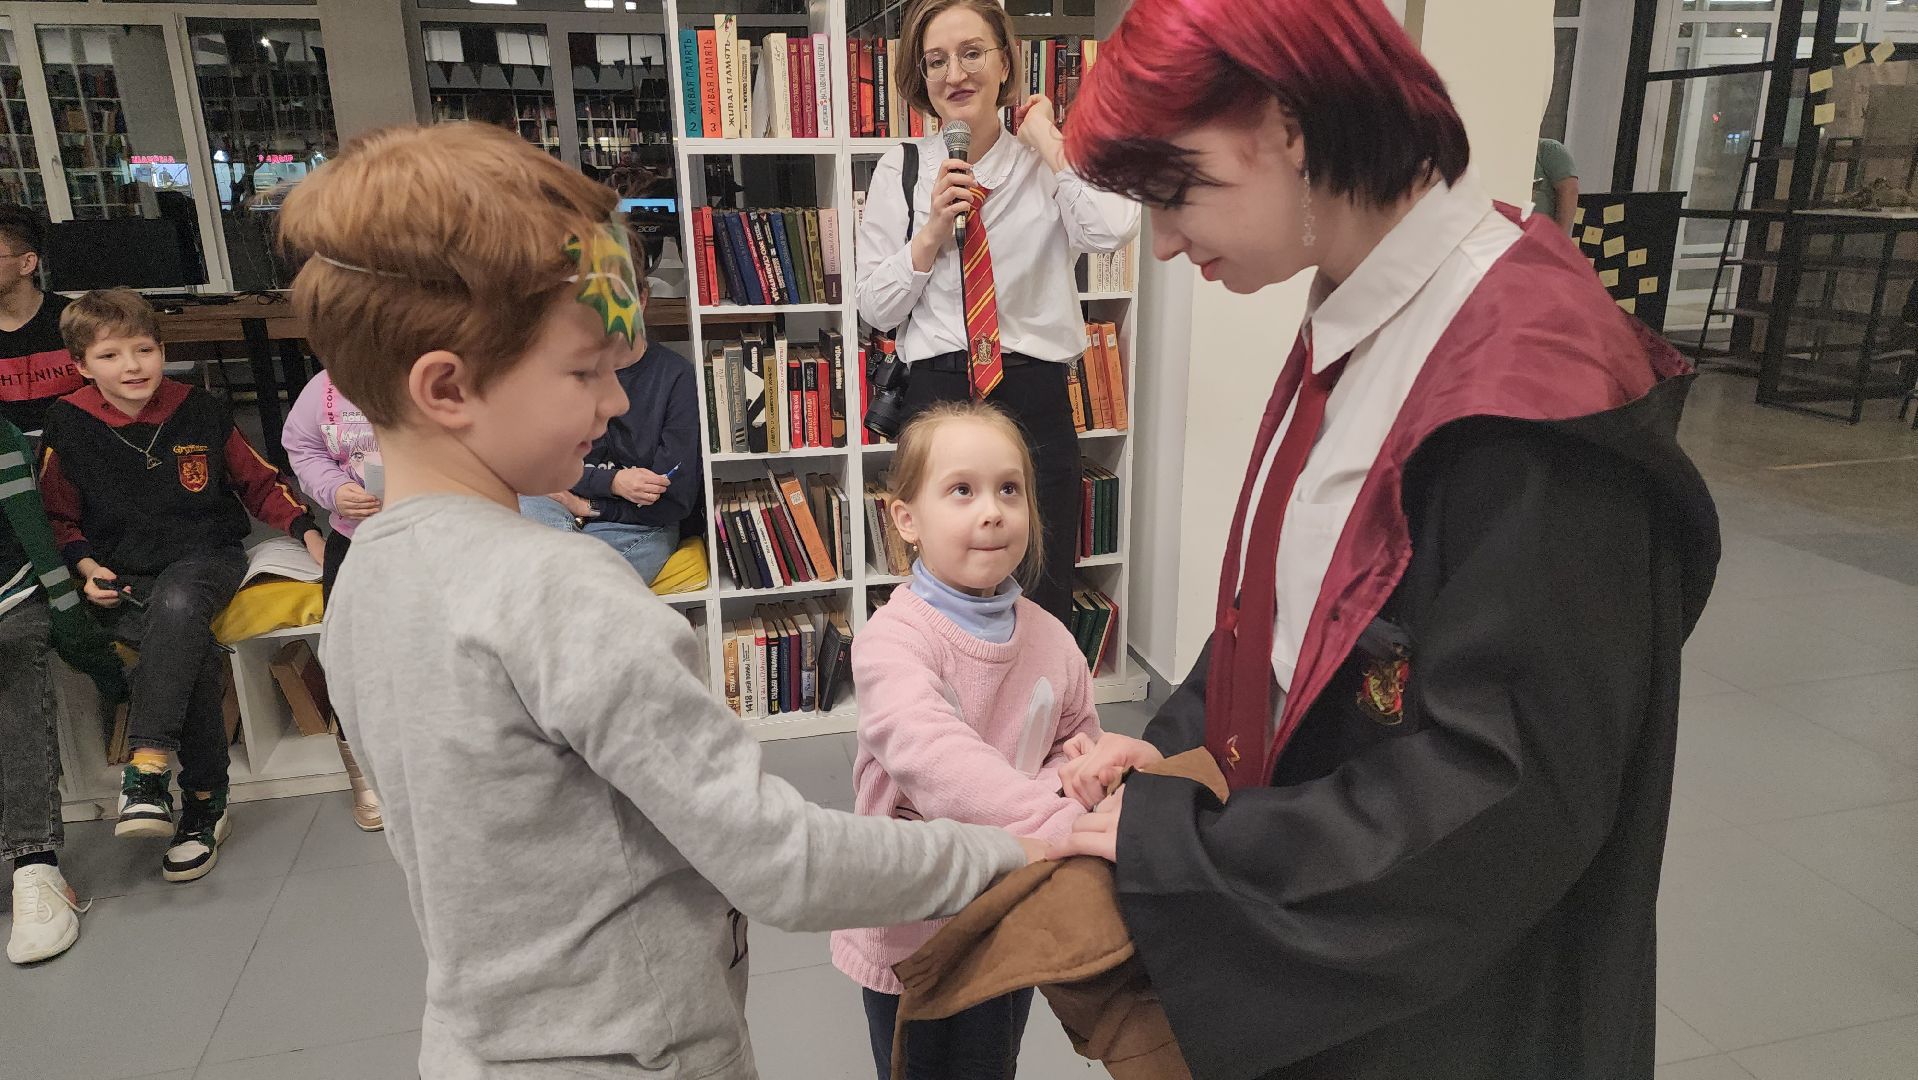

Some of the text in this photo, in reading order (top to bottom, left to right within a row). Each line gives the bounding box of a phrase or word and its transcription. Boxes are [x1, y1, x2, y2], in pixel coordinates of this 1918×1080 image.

[684, 38, 698, 132] 2 ЖИВАЯ ПАМЯТЬ
[704, 39, 717, 132] 3 ЖИВАЯ ПАМЯТЬ
[724, 39, 735, 127] ЖИВАЯ ПАМЯТЬ
[637, 225, 661, 233] acer
[759, 240, 767, 255] ЭХО
[762, 255, 780, 302] СТАЛИНГРАДА
[745, 695, 753, 713] 1418
